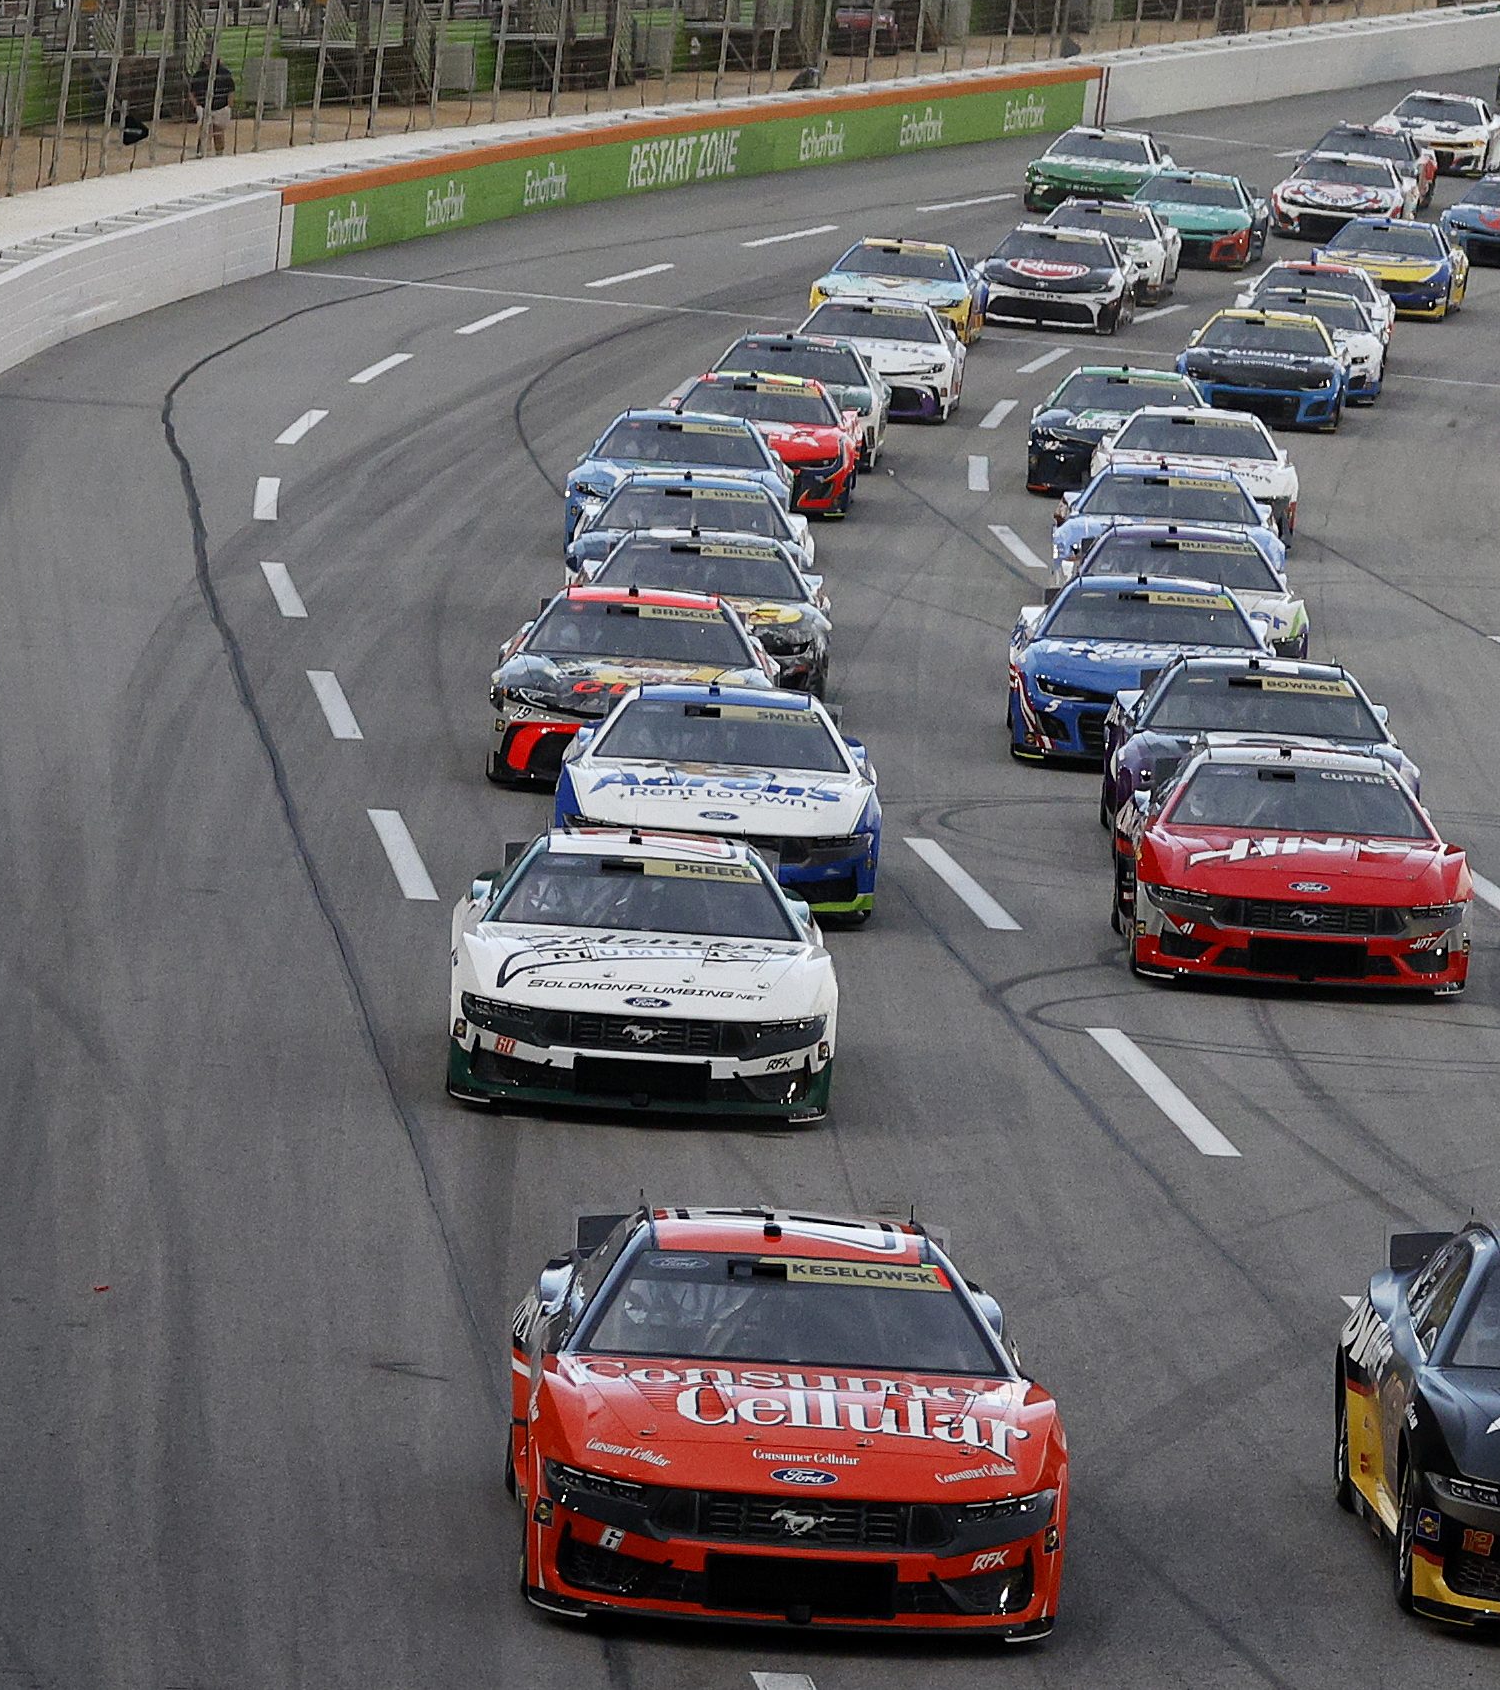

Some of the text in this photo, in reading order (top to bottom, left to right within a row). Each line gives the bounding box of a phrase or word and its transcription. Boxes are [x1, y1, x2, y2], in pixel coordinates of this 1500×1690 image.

[899, 107, 944, 147] EchoPark
[1002, 94, 1046, 132] EchoPark
[800, 121, 844, 162] EchoPark
[628, 130, 739, 187] RESTART ZONE
[524, 162, 567, 207] EchoPark
[426, 181, 466, 227] EchoPark
[327, 201, 369, 249] EchoPark
[1267, 679, 1341, 693] BOWMAN
[629, 786, 807, 808] Rent to Own
[1180, 922, 1195, 935] 41
[494, 1034, 516, 1055] 60
[580, 1361, 1003, 1400] Consumer
[676, 1385, 1031, 1462] Cellular
[586, 1436, 671, 1467] Consumer Cellular
[752, 1448, 860, 1466] Consumer Cellular
[781, 1468, 827, 1485] Ford
[603, 1527, 624, 1550] 6
[1462, 1528, 1494, 1555] 12
[970, 1550, 1010, 1572] RFK
